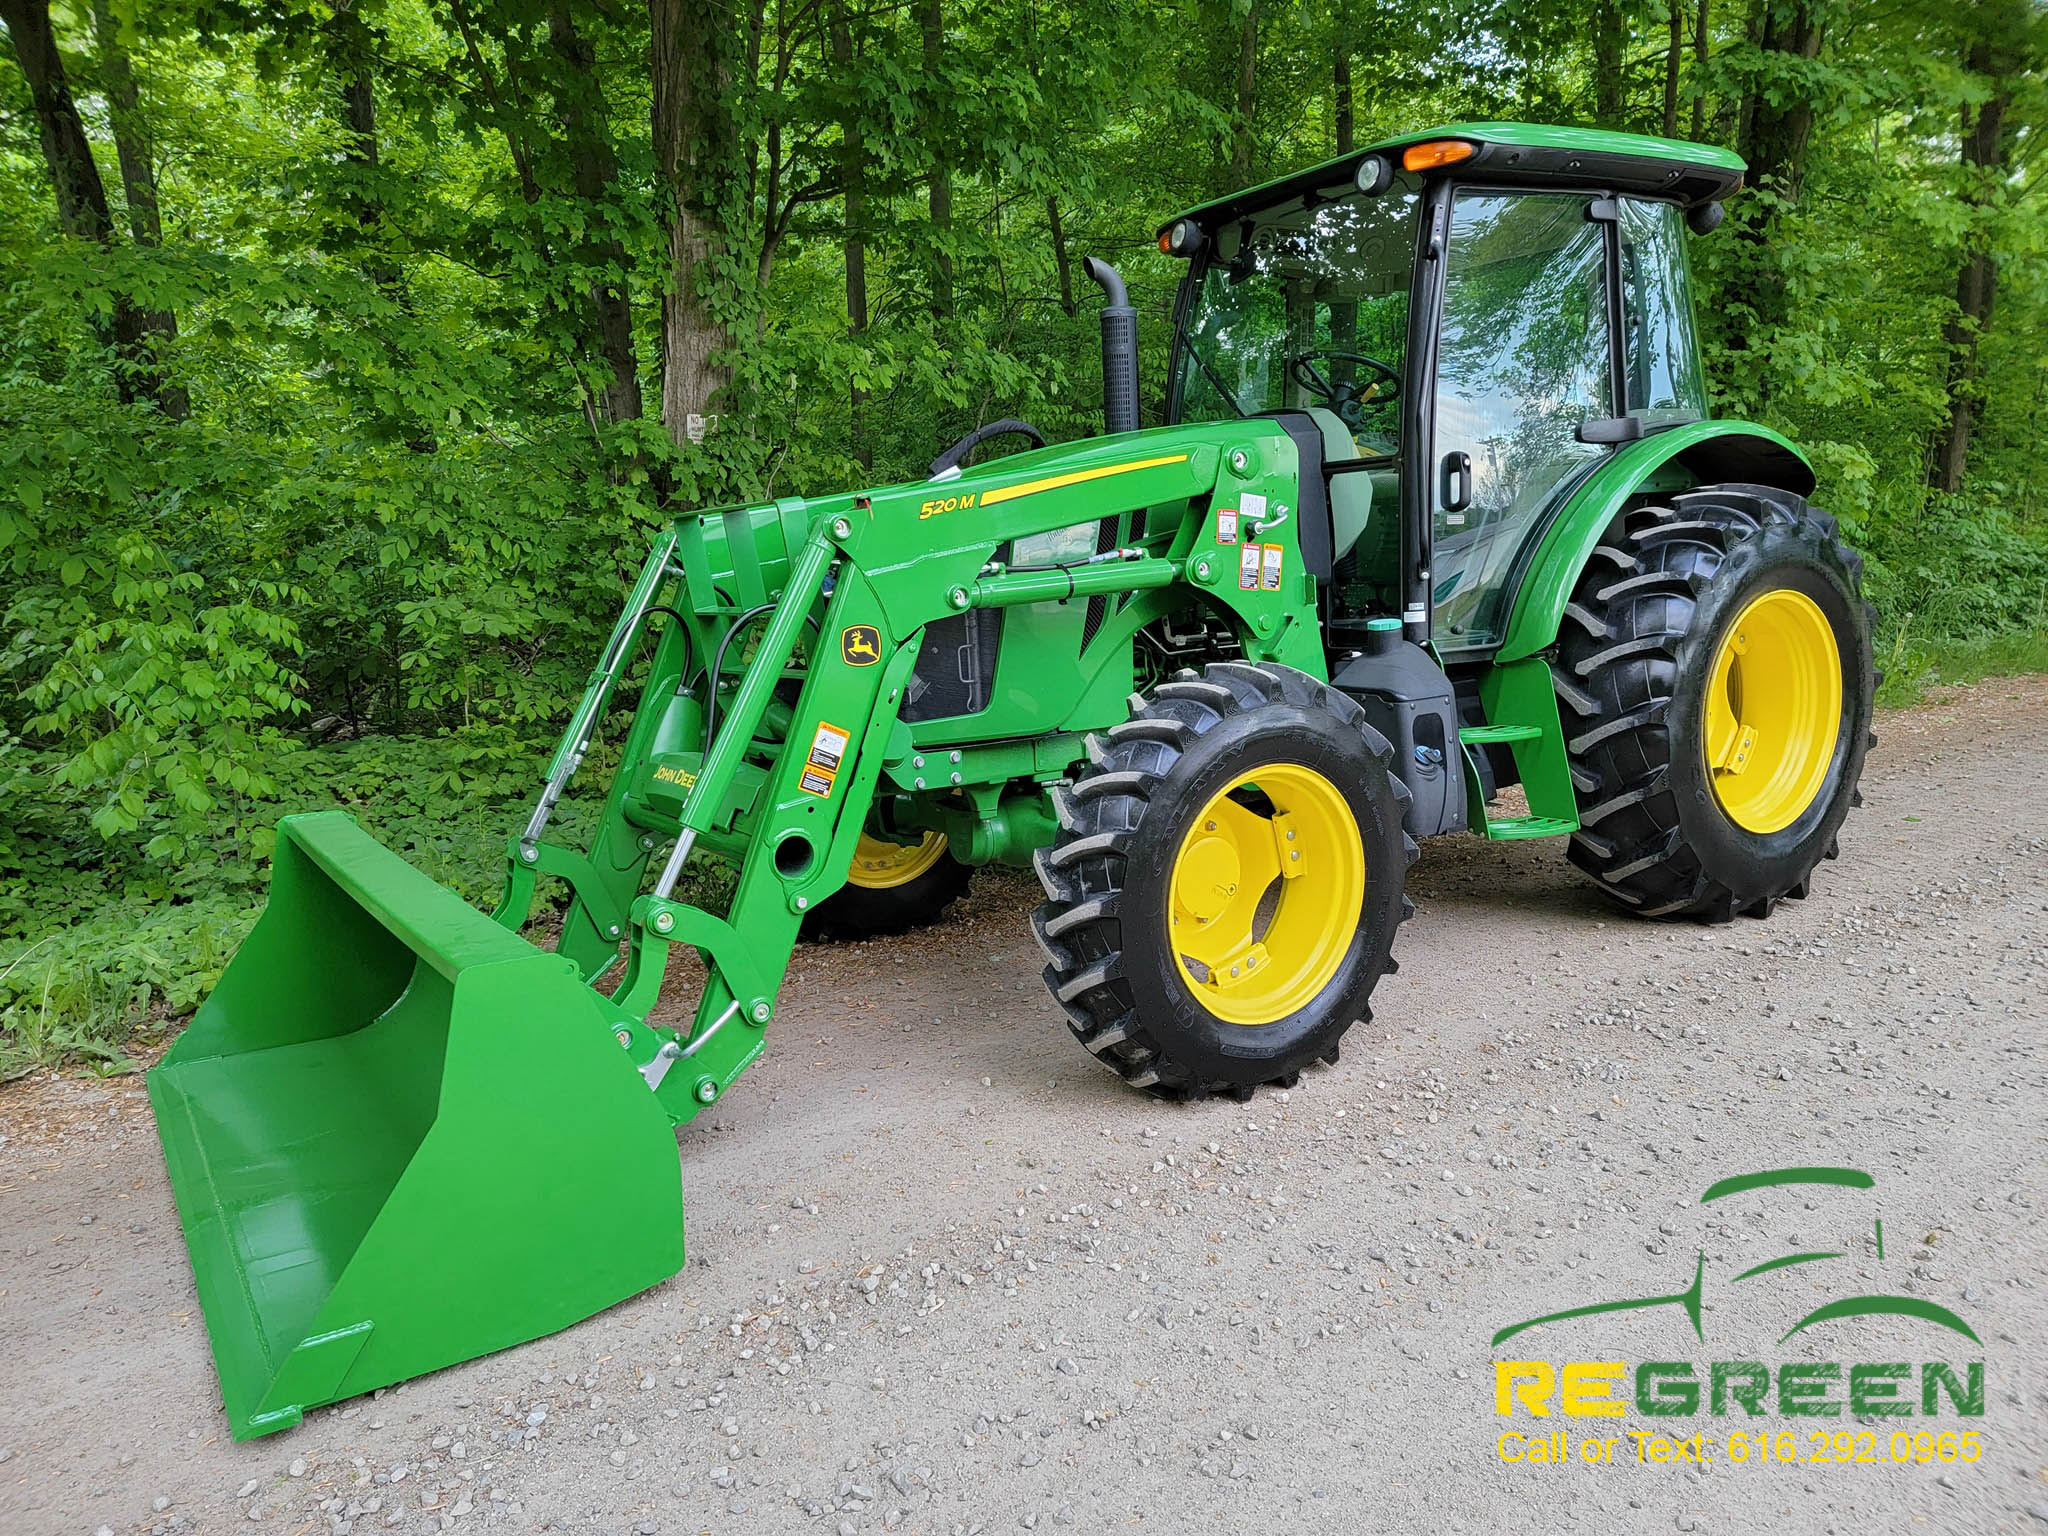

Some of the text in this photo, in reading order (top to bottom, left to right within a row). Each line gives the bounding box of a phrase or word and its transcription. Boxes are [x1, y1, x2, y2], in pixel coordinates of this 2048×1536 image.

[919, 493, 976, 520] 520 M
[653, 764, 697, 788] JOHN DEE
